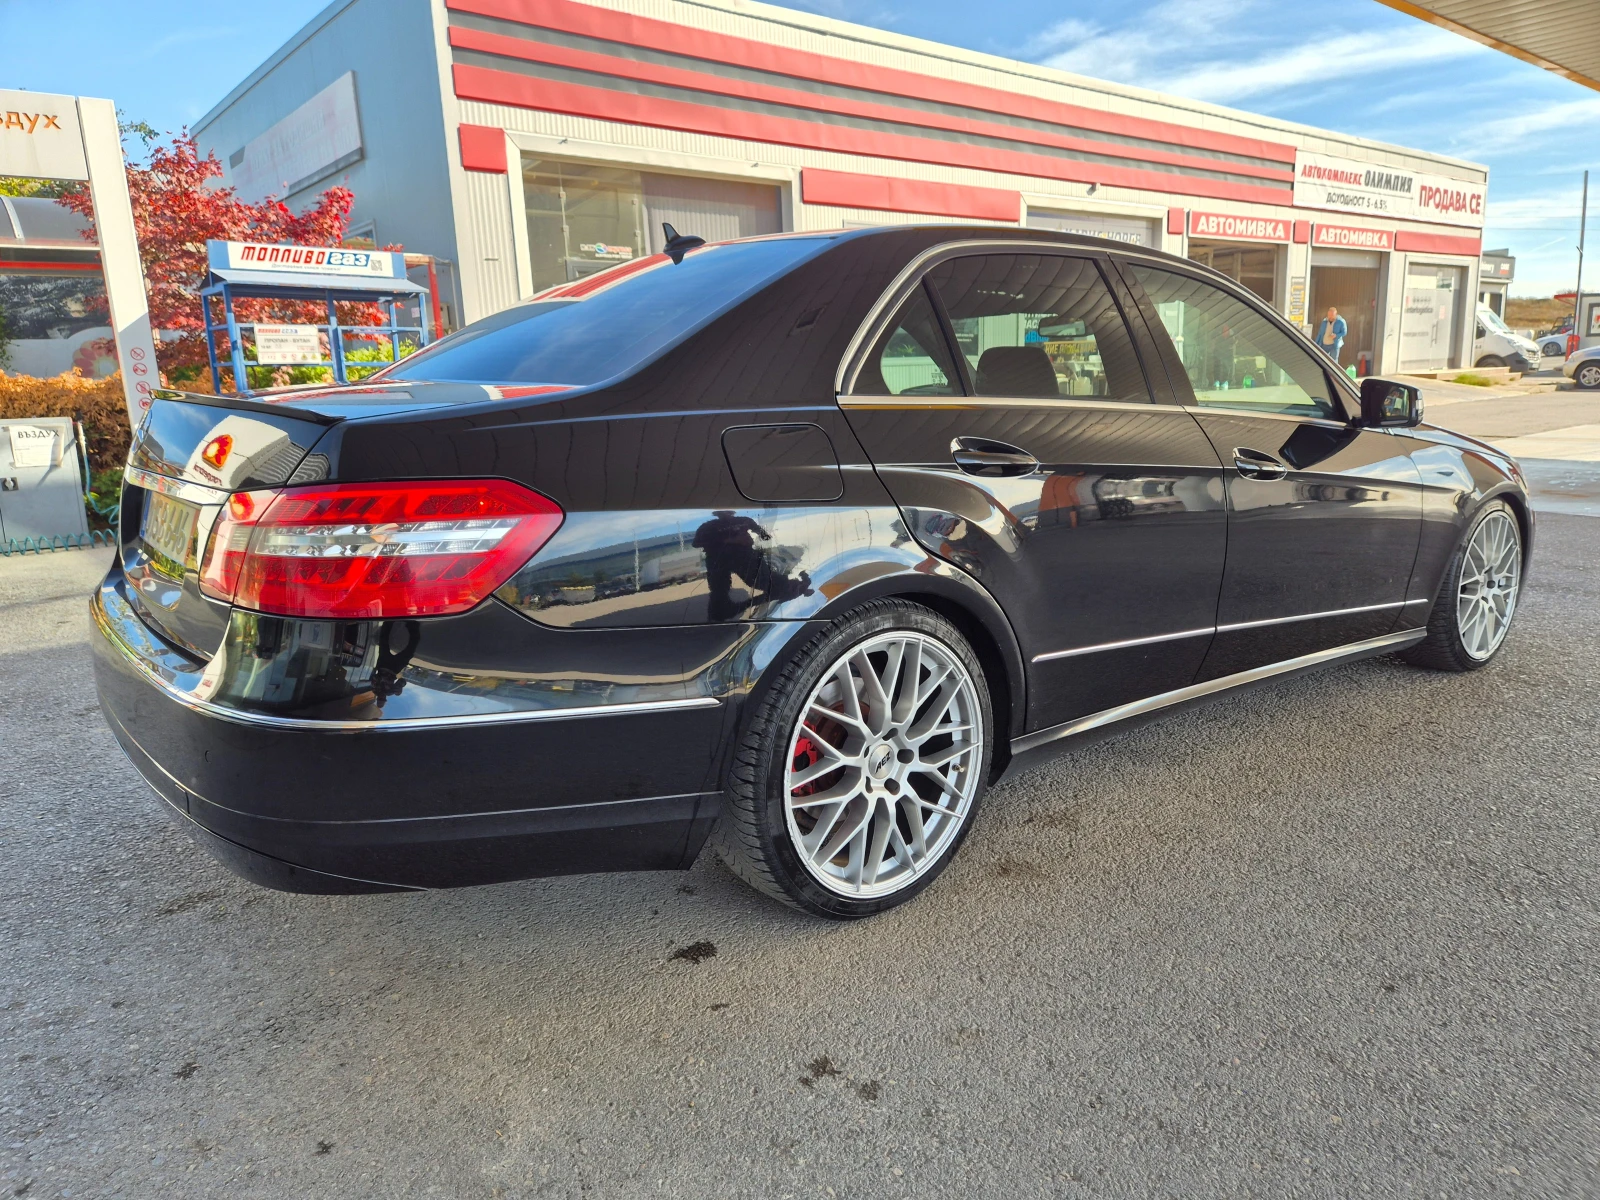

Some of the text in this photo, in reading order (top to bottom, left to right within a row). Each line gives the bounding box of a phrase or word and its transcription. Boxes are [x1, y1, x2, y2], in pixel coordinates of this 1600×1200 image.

[0, 110, 62, 134] дух
[1301, 164, 1413, 194] АВТОКОМПЛЕКС ОЛИМПИЯ
[1326, 192, 1365, 206] ДОХОДНОСТ
[1419, 184, 1482, 215] ПРОДАВА СЕ
[1196, 215, 1286, 239] АВТОМИВКА
[1318, 227, 1389, 248] АВТОМИВКА
[17, 429, 60, 439] ВЪЗДУХ
[875, 750, 891, 774] AEZ
